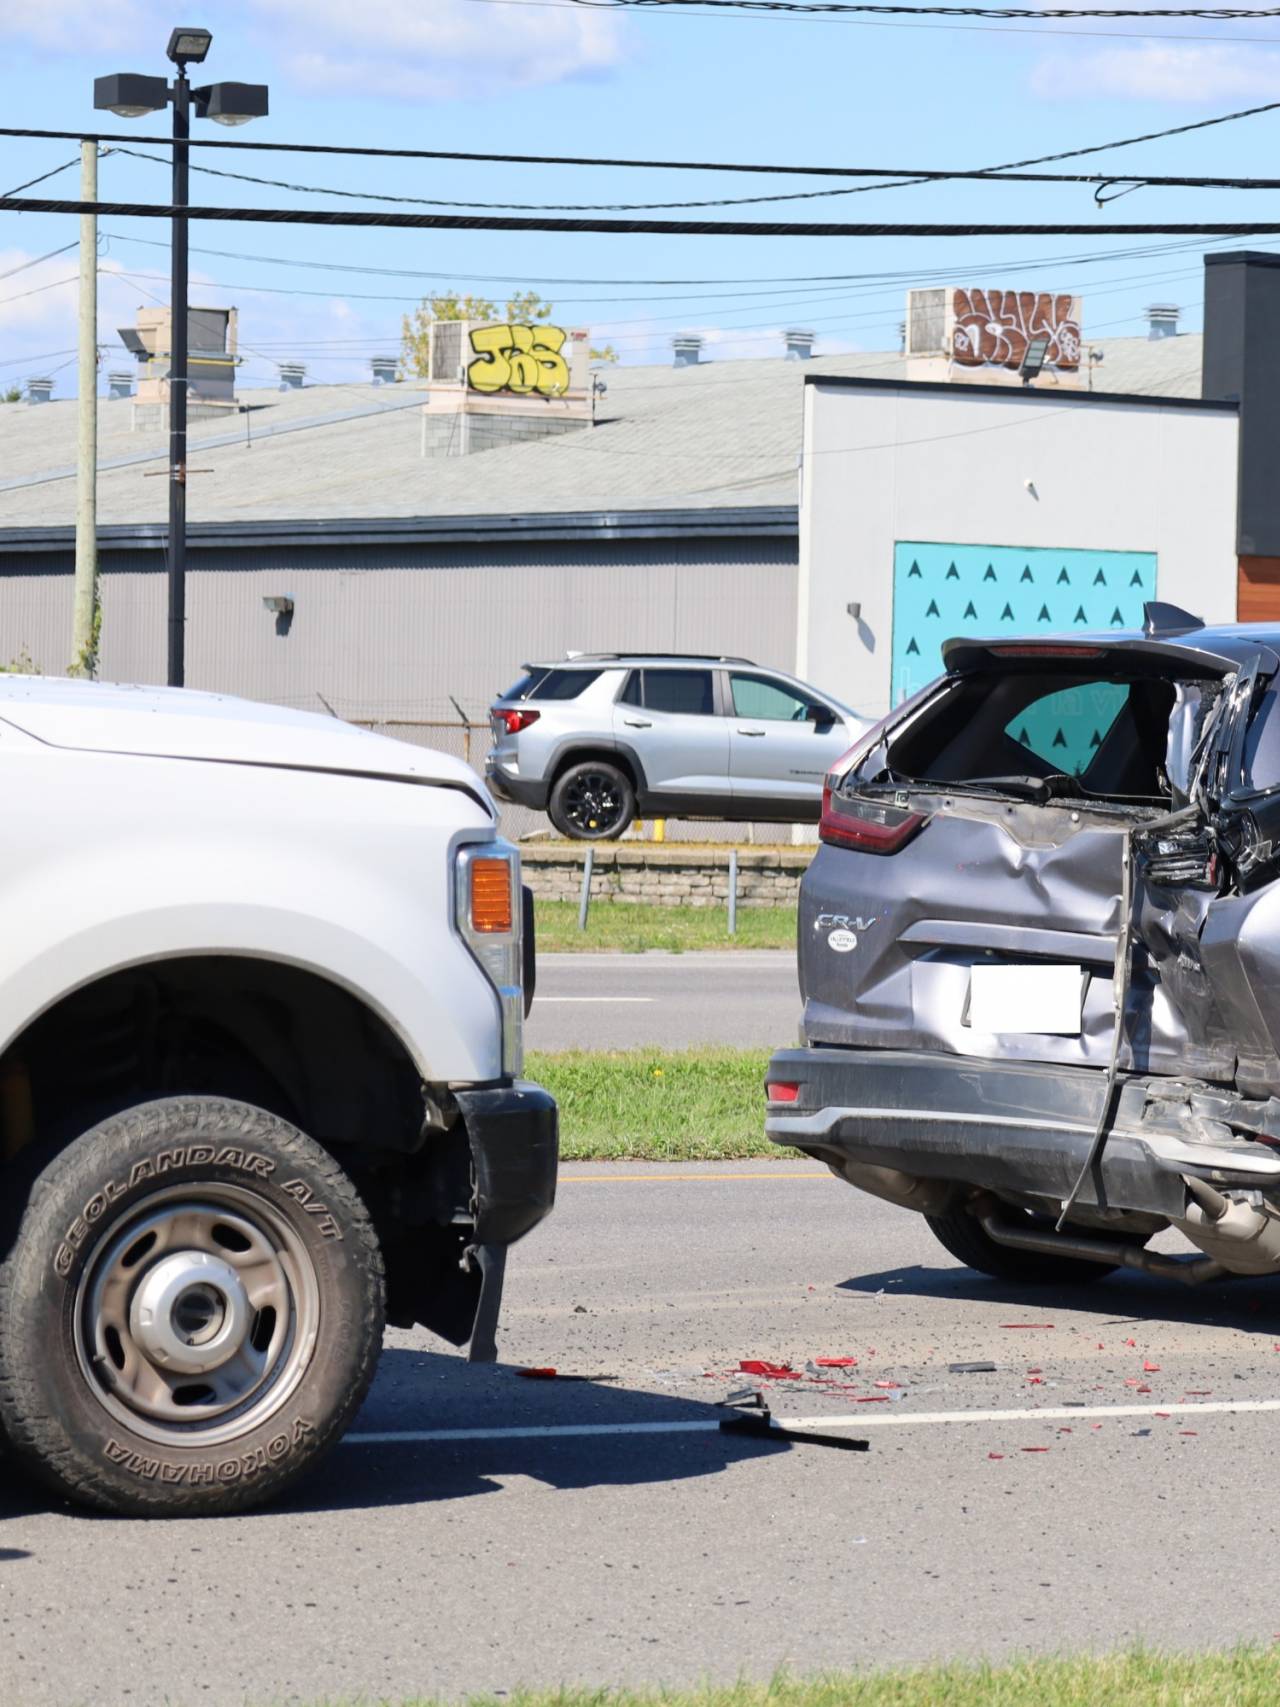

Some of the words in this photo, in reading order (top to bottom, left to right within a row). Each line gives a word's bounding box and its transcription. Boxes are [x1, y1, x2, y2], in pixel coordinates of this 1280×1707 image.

[814, 914, 877, 931] CR-V
[54, 1145, 277, 1277] GEOLANDAR
[280, 1178, 344, 1241] A/T
[103, 1415, 314, 1484] YOKOHAMA
